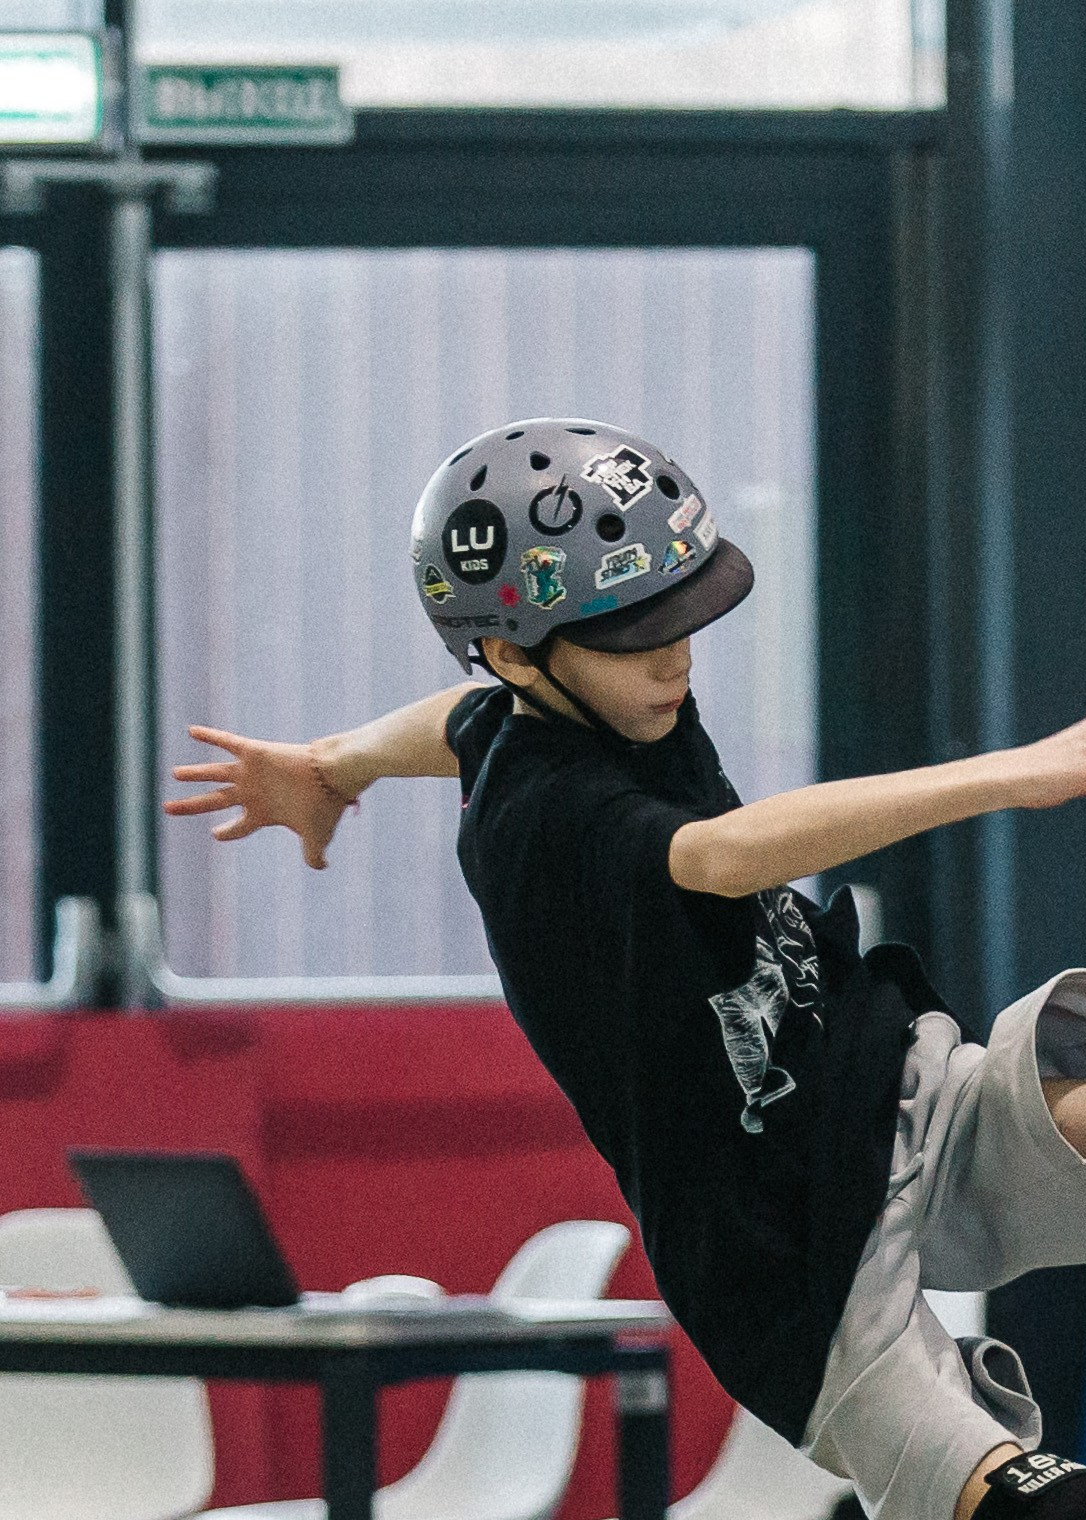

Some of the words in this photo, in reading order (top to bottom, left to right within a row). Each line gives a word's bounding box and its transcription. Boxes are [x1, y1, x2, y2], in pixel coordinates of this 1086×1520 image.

[451, 525, 495, 553] LU
[460, 558, 489, 572] KIDS
[1006, 1453, 1060, 1484] 18
[1017, 1466, 1066, 1494] KILLER
